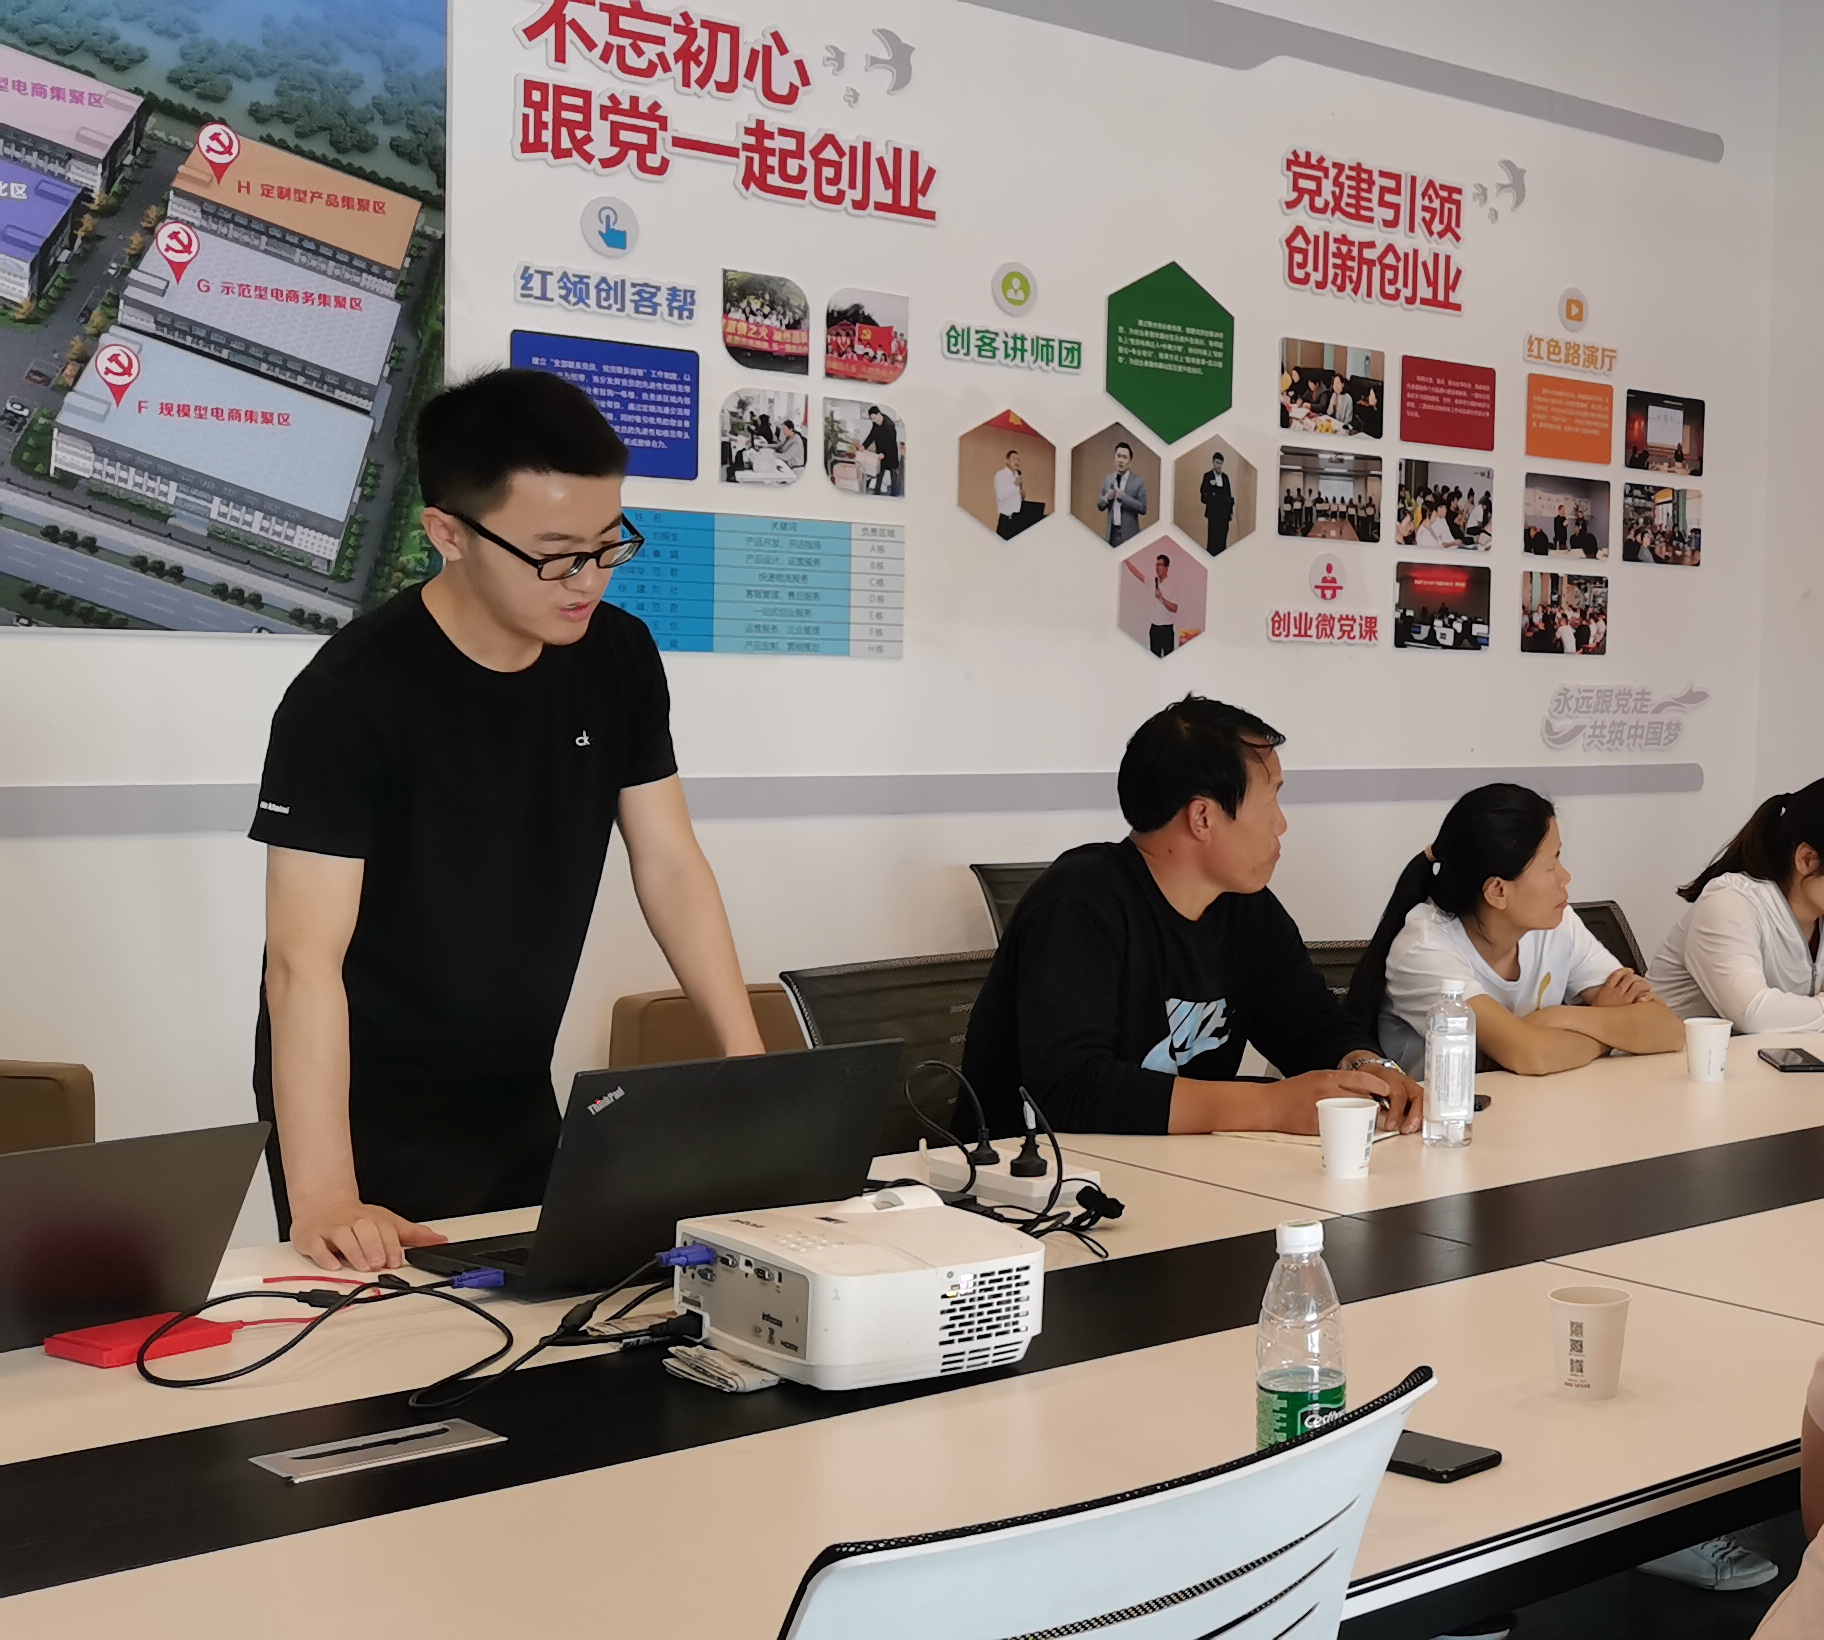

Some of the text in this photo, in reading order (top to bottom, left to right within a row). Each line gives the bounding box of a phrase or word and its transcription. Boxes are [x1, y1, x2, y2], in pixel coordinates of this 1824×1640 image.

[522, 0, 811, 105] 不忘初心
[520, 79, 938, 221] 跟党一起创业
[237, 180, 387, 216] H 定制型产品集聚区
[1285, 150, 1463, 243] 党建引领
[197, 277, 211, 294] G
[1284, 225, 1463, 312] 创新创业
[520, 266, 696, 320] 红领创客帮
[946, 324, 1083, 370] 创客讲师团
[1526, 335, 1619, 372] 红色路演厅
[159, 402, 292, 427] 规模型电商集聚区
[1271, 611, 1379, 642] 创业微党课
[1553, 687, 1653, 715] 永远跟党走
[1585, 720, 1683, 748] 共筑中国梦
